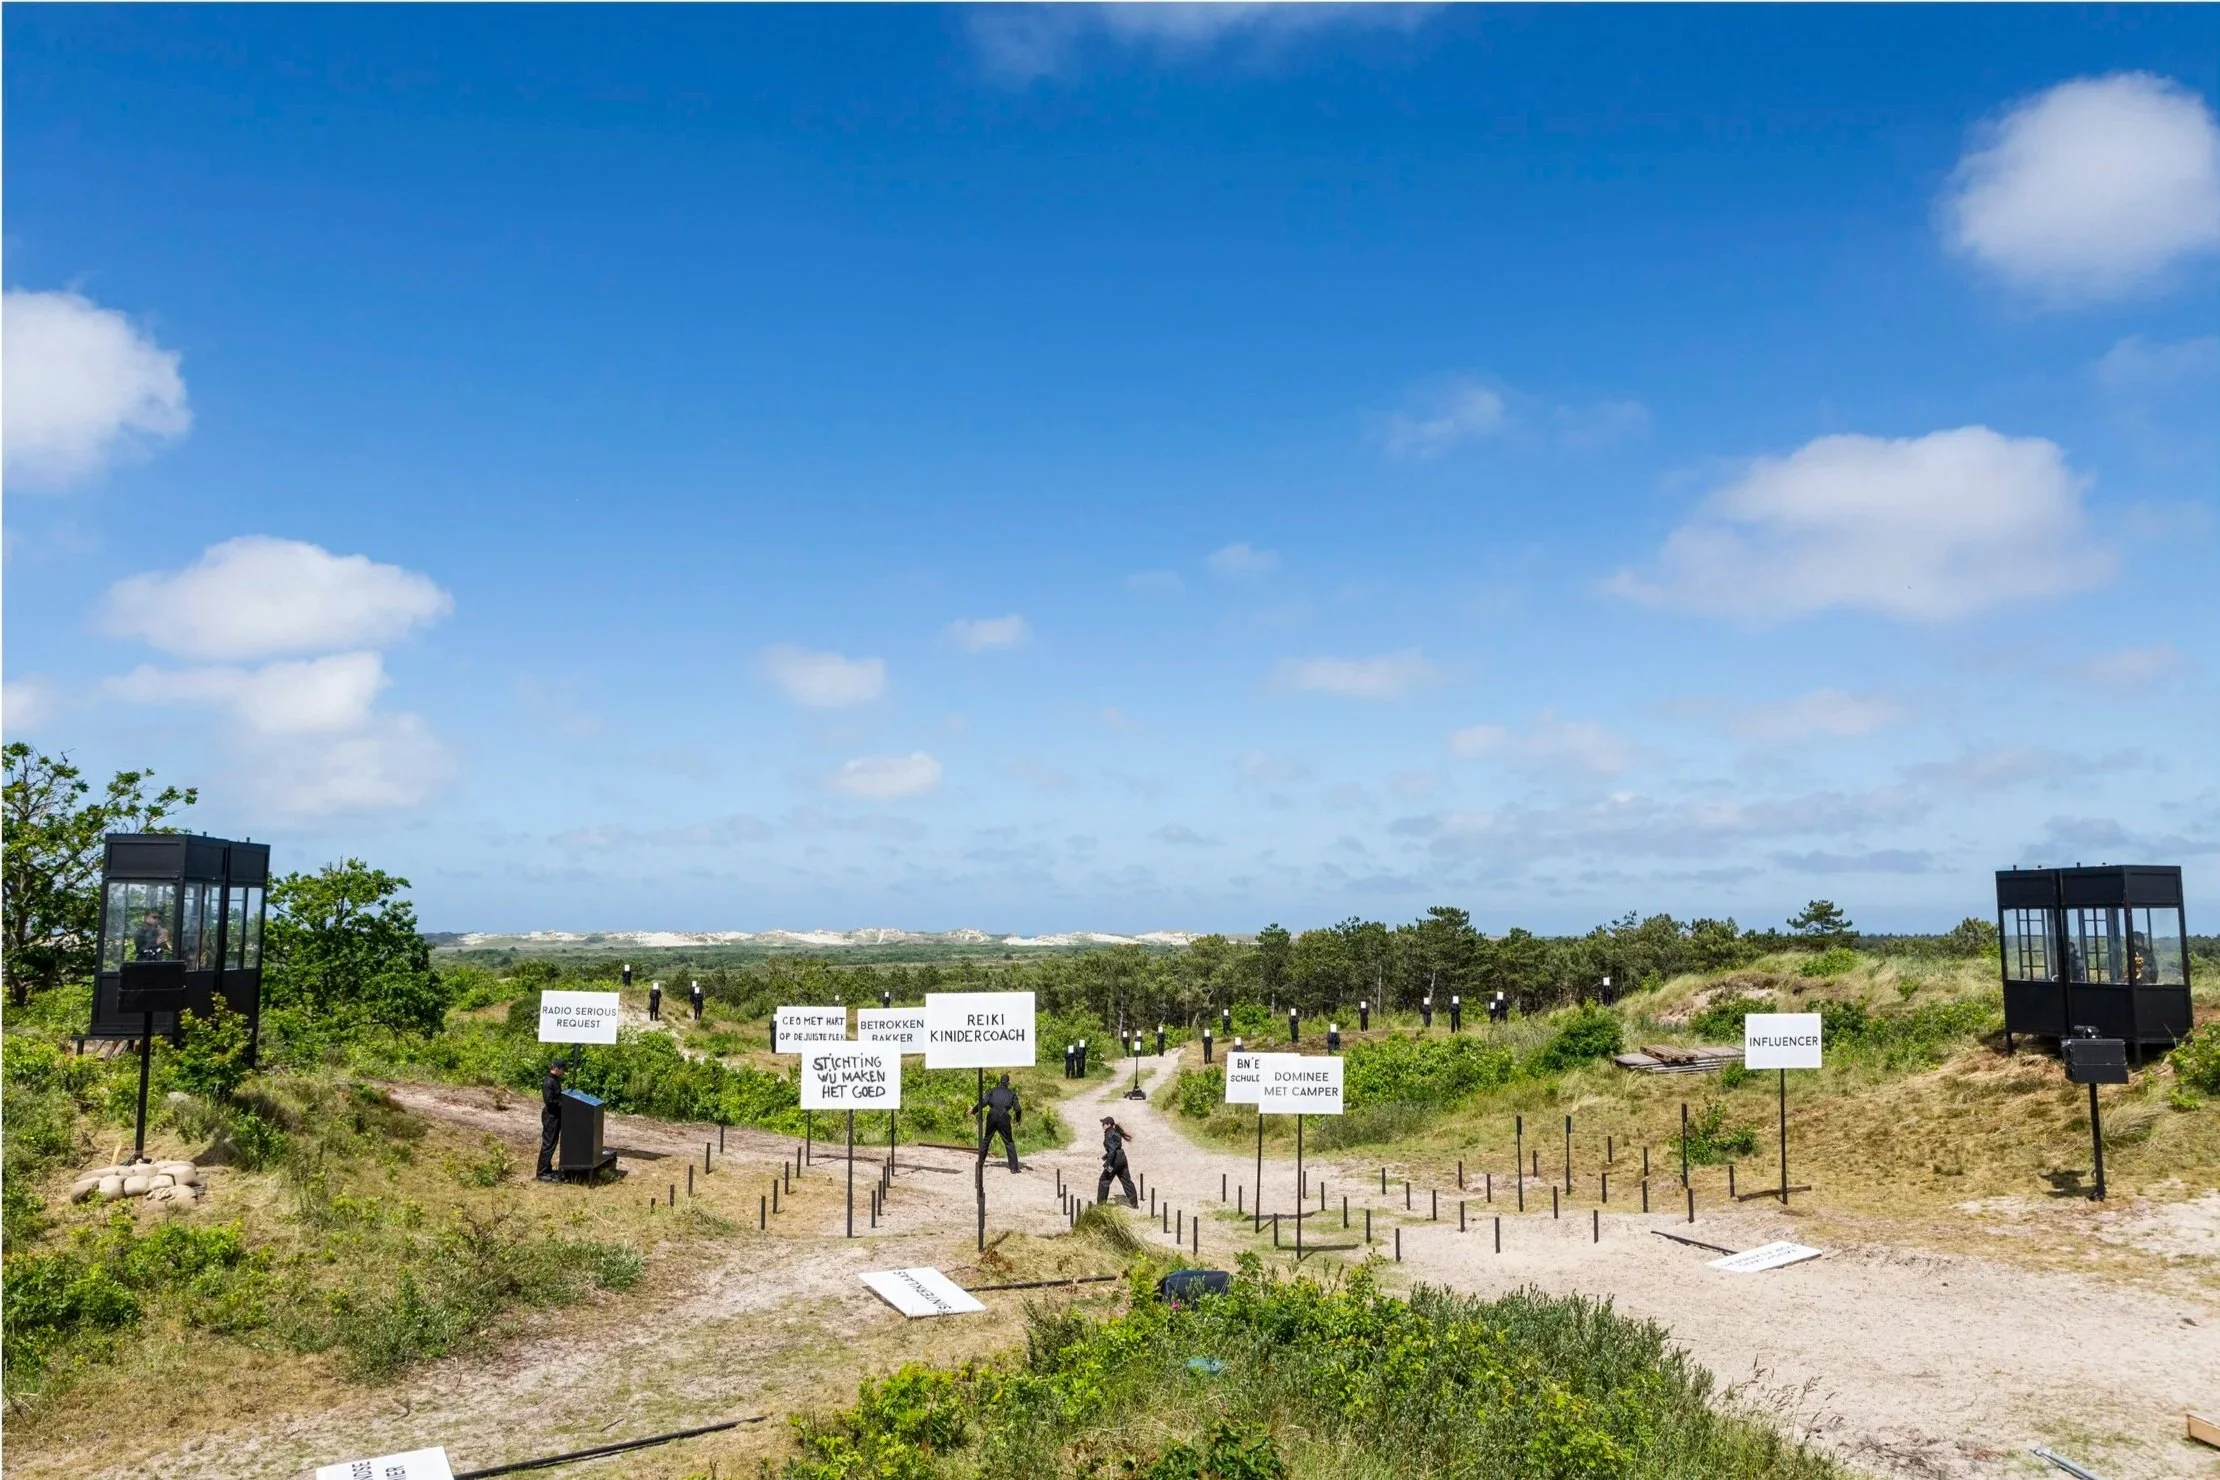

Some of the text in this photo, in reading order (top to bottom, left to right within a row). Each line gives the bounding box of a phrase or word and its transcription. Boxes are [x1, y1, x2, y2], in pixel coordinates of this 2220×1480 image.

[542, 1006, 617, 1017] RADIO SERIOUS
[556, 1018, 601, 1029] REQUEST
[782, 1016, 845, 1026] CEO MET HART
[860, 1019, 924, 1030] BETROKKEN
[967, 1013, 1005, 1026] REIKI
[779, 1032, 791, 1041] OP
[872, 1033, 913, 1043] BAKKER
[1749, 1036, 1819, 1047] INFLUENCER
[842, 1069, 885, 1083] MAKEN
[1274, 1071, 1329, 1082] DOMINEE
[822, 1084, 886, 1099] HET GOED
[1264, 1086, 1339, 1097] MET CAMPER
